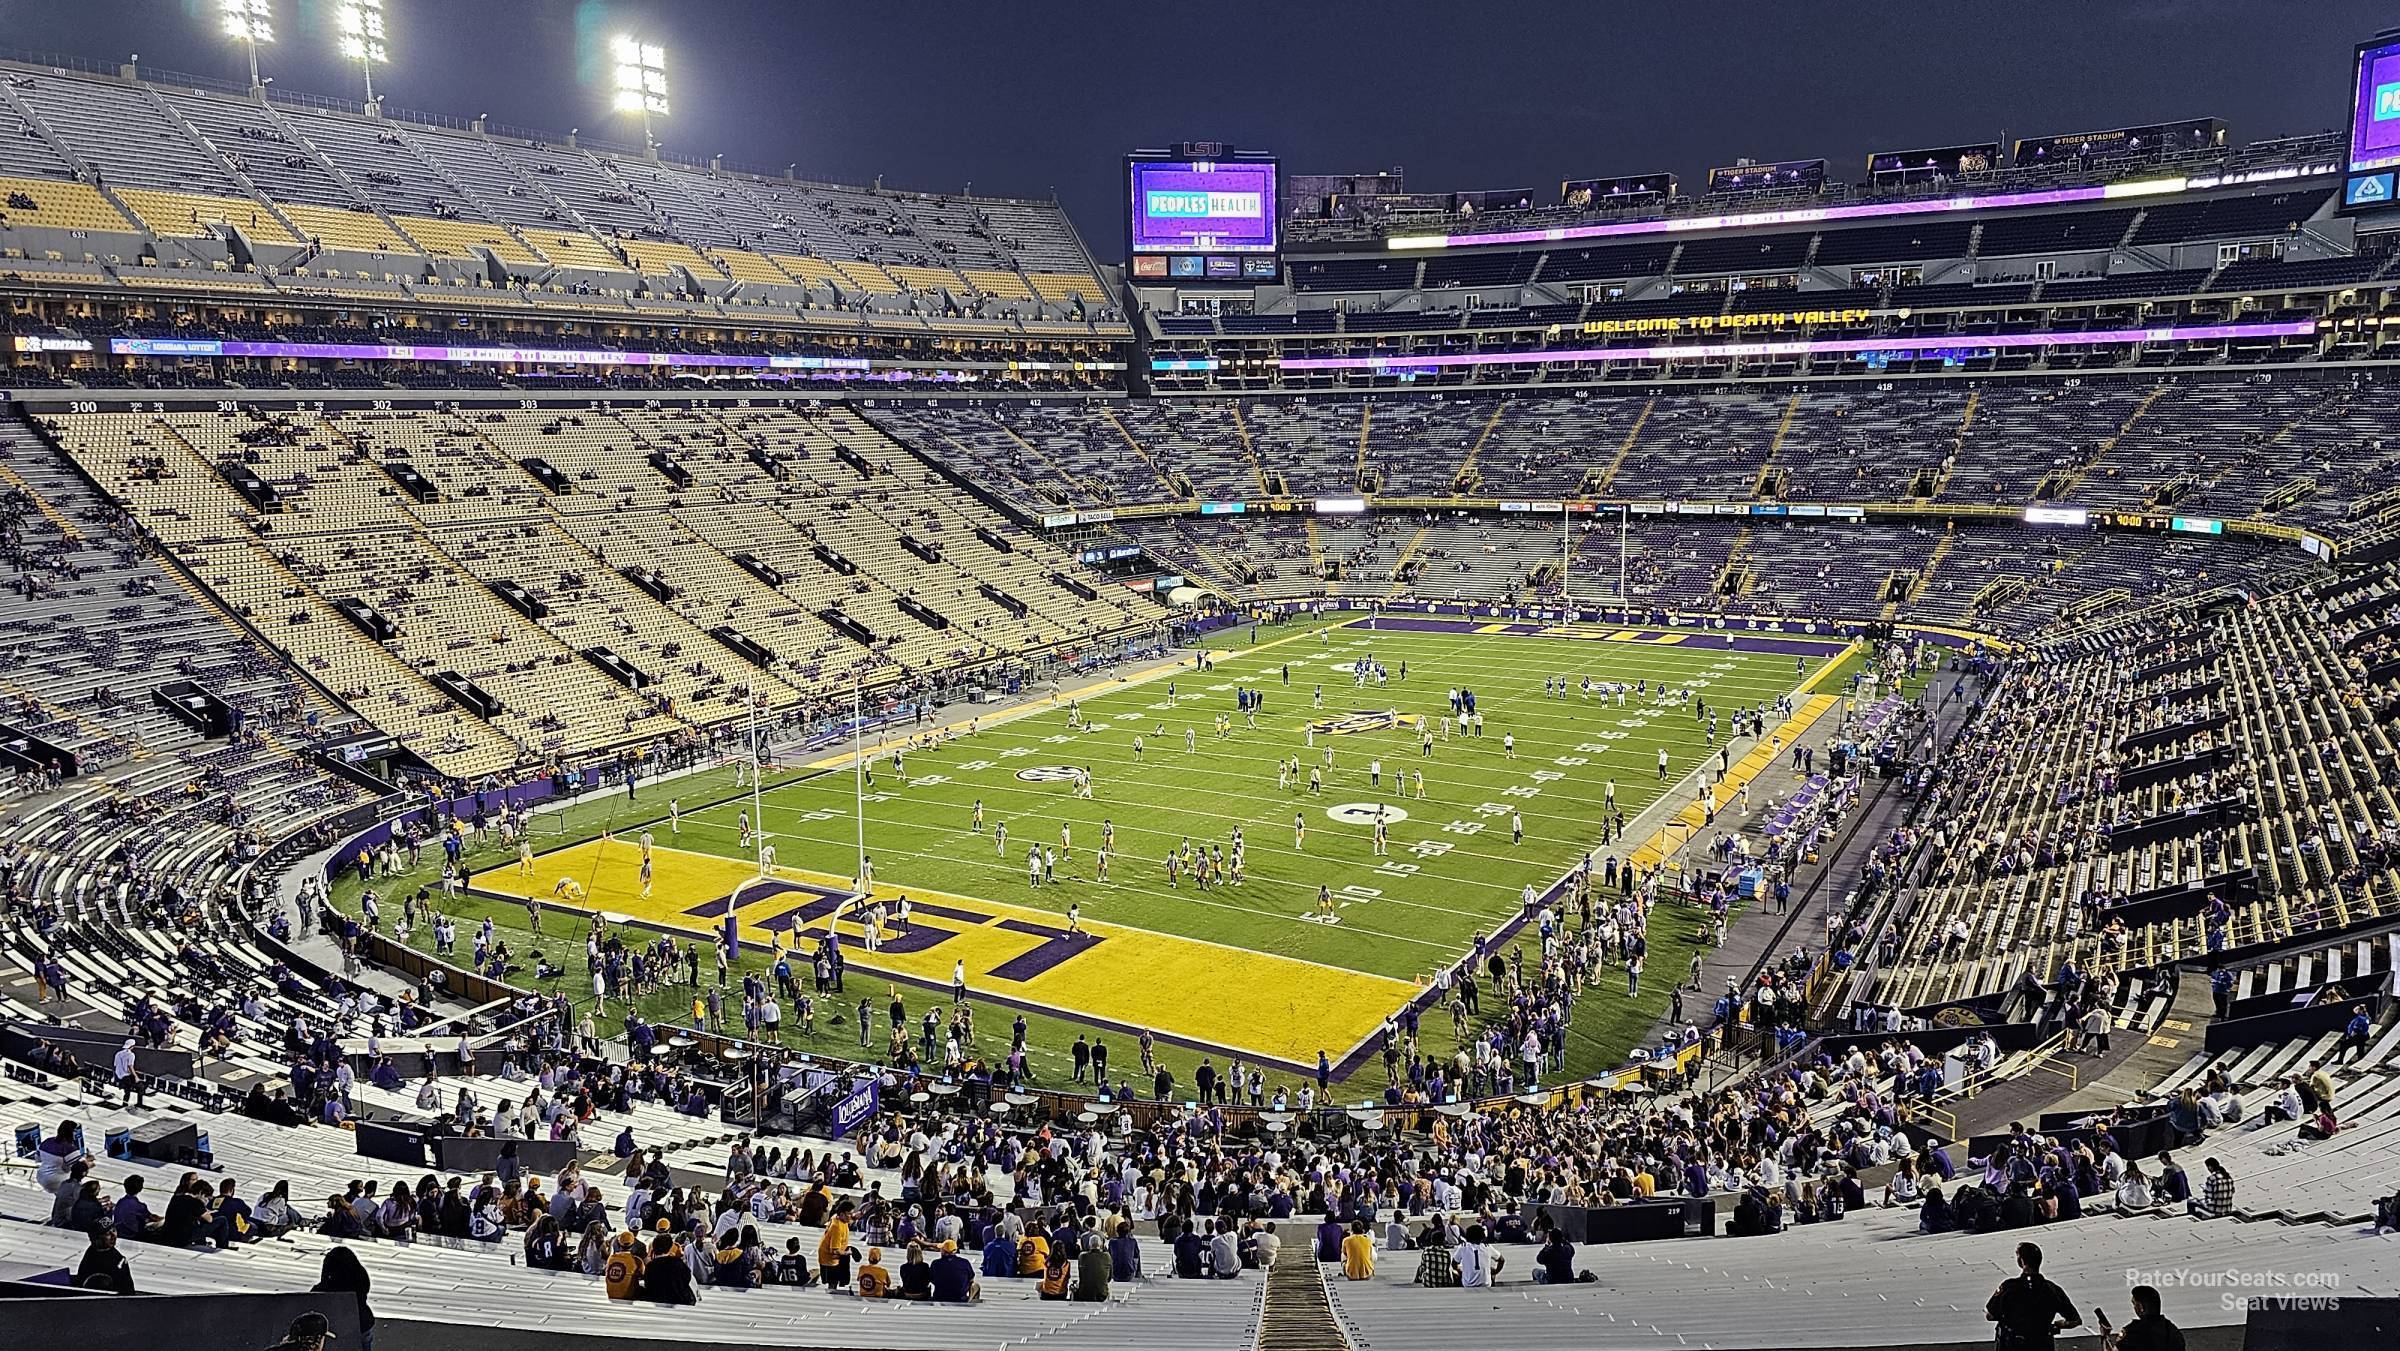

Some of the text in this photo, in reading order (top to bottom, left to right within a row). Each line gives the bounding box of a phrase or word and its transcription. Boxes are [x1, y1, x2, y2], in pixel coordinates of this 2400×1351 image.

[2061, 131, 2125, 144] TIGER STADIUM
[1183, 142, 1222, 157] LSU
[1723, 165, 1777, 176] TIGER STADIUM
[1151, 195, 1257, 213] PEOPLES HEALTH
[72, 231, 87, 239] 632
[1584, 309, 1870, 333] WELCOME TO DEATH VALLEY
[1877, 383, 1893, 391] 418
[2065, 379, 2081, 388] 419
[1575, 390, 1587, 398] 416
[70, 402, 97, 413] 300
[216, 401, 239, 412] 301
[372, 400, 393, 411] 302
[520, 400, 538, 409] 303
[737, 400, 750, 408] 305
[1270, 503, 1292, 511] 90:00
[1087, 511, 1112, 521] TACO BELL
[2117, 515, 2142, 526] 90:00
[1350, 602, 1371, 610] LSU
[1472, 624, 1691, 644] LSU
[1472, 802, 1516, 816] 30
[1441, 820, 1487, 836] 25
[1408, 840, 1455, 856] 20
[1373, 861, 1422, 878] 15
[1332, 885, 1384, 904] 10
[682, 882, 1107, 982] LSU
[838, 1087, 873, 1124] LOUISIANA
[950, 1145, 957, 1155] 8
[544, 1241, 553, 1258] 8
[1474, 1249, 1480, 1271] 1
[783, 1269, 798, 1282] 16
